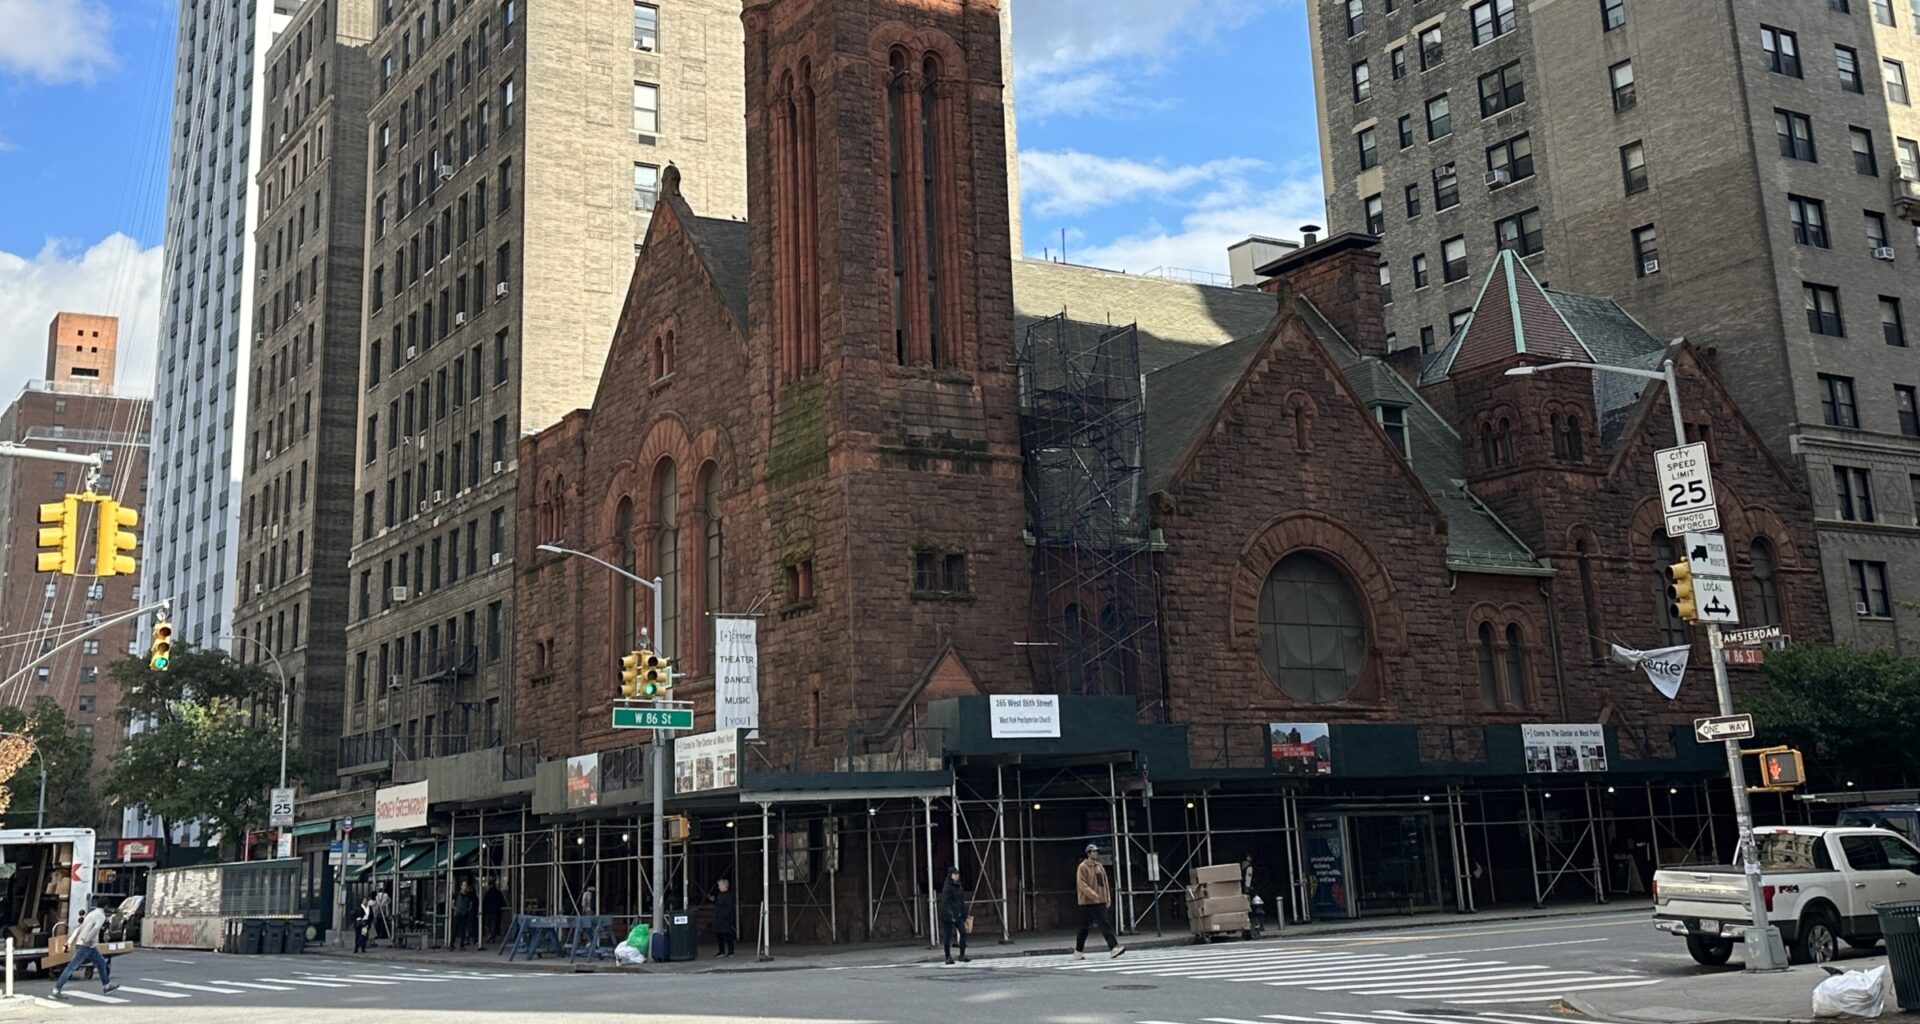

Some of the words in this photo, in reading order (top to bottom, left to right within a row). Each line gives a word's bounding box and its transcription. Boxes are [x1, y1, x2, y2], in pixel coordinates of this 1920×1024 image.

[1670, 450, 1690, 460] CITY
[1666, 459, 1696, 472] SPEED
[1672, 469, 1694, 480] LIMIT
[1668, 479, 1707, 508] 25
[1678, 513, 1704, 523] PHOTO
[1672, 519, 1714, 532] ENFORCED
[1708, 543, 1724, 552] TRUCK
[1710, 558, 1727, 568] ROUTE
[1702, 582, 1723, 592] LOCAL
[1724, 627, 1780, 644] AMSTERDAM
[720, 656, 754, 664] THEATER
[1733, 650, 1744, 662] 86
[1746, 650, 1755, 663] ST
[724, 676, 752, 684] DANCE
[725, 696, 751, 704] MUSIC
[1008, 699, 1022, 707] West
[1036, 699, 1053, 708] Street
[634, 712, 644, 724] W
[646, 712, 658, 724] 86
[662, 712, 672, 724] St
[1703, 725, 1720, 734] ONE
[1728, 722, 1747, 732] WAY
[274, 804, 291, 814] 25
[1778, 884, 1799, 894] FX4
